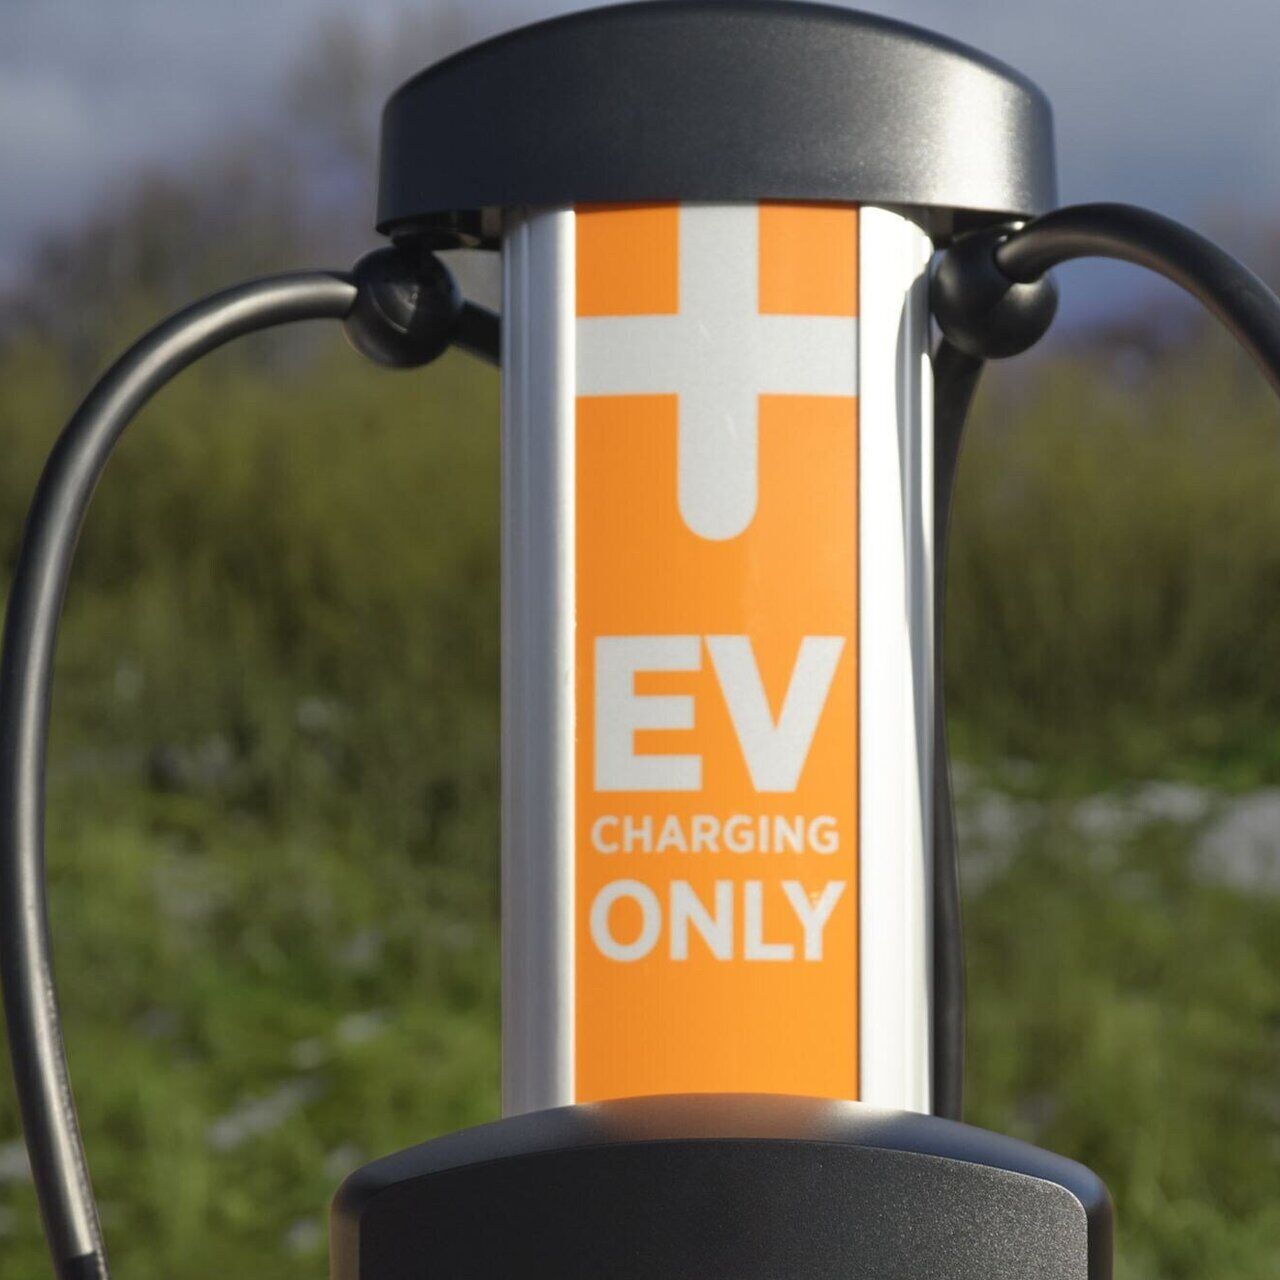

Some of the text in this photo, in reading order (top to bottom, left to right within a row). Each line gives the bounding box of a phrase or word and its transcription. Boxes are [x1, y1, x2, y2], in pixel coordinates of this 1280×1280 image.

[593, 634, 847, 793] EV
[590, 814, 840, 854] CHARGING
[589, 879, 847, 963] ONLY
